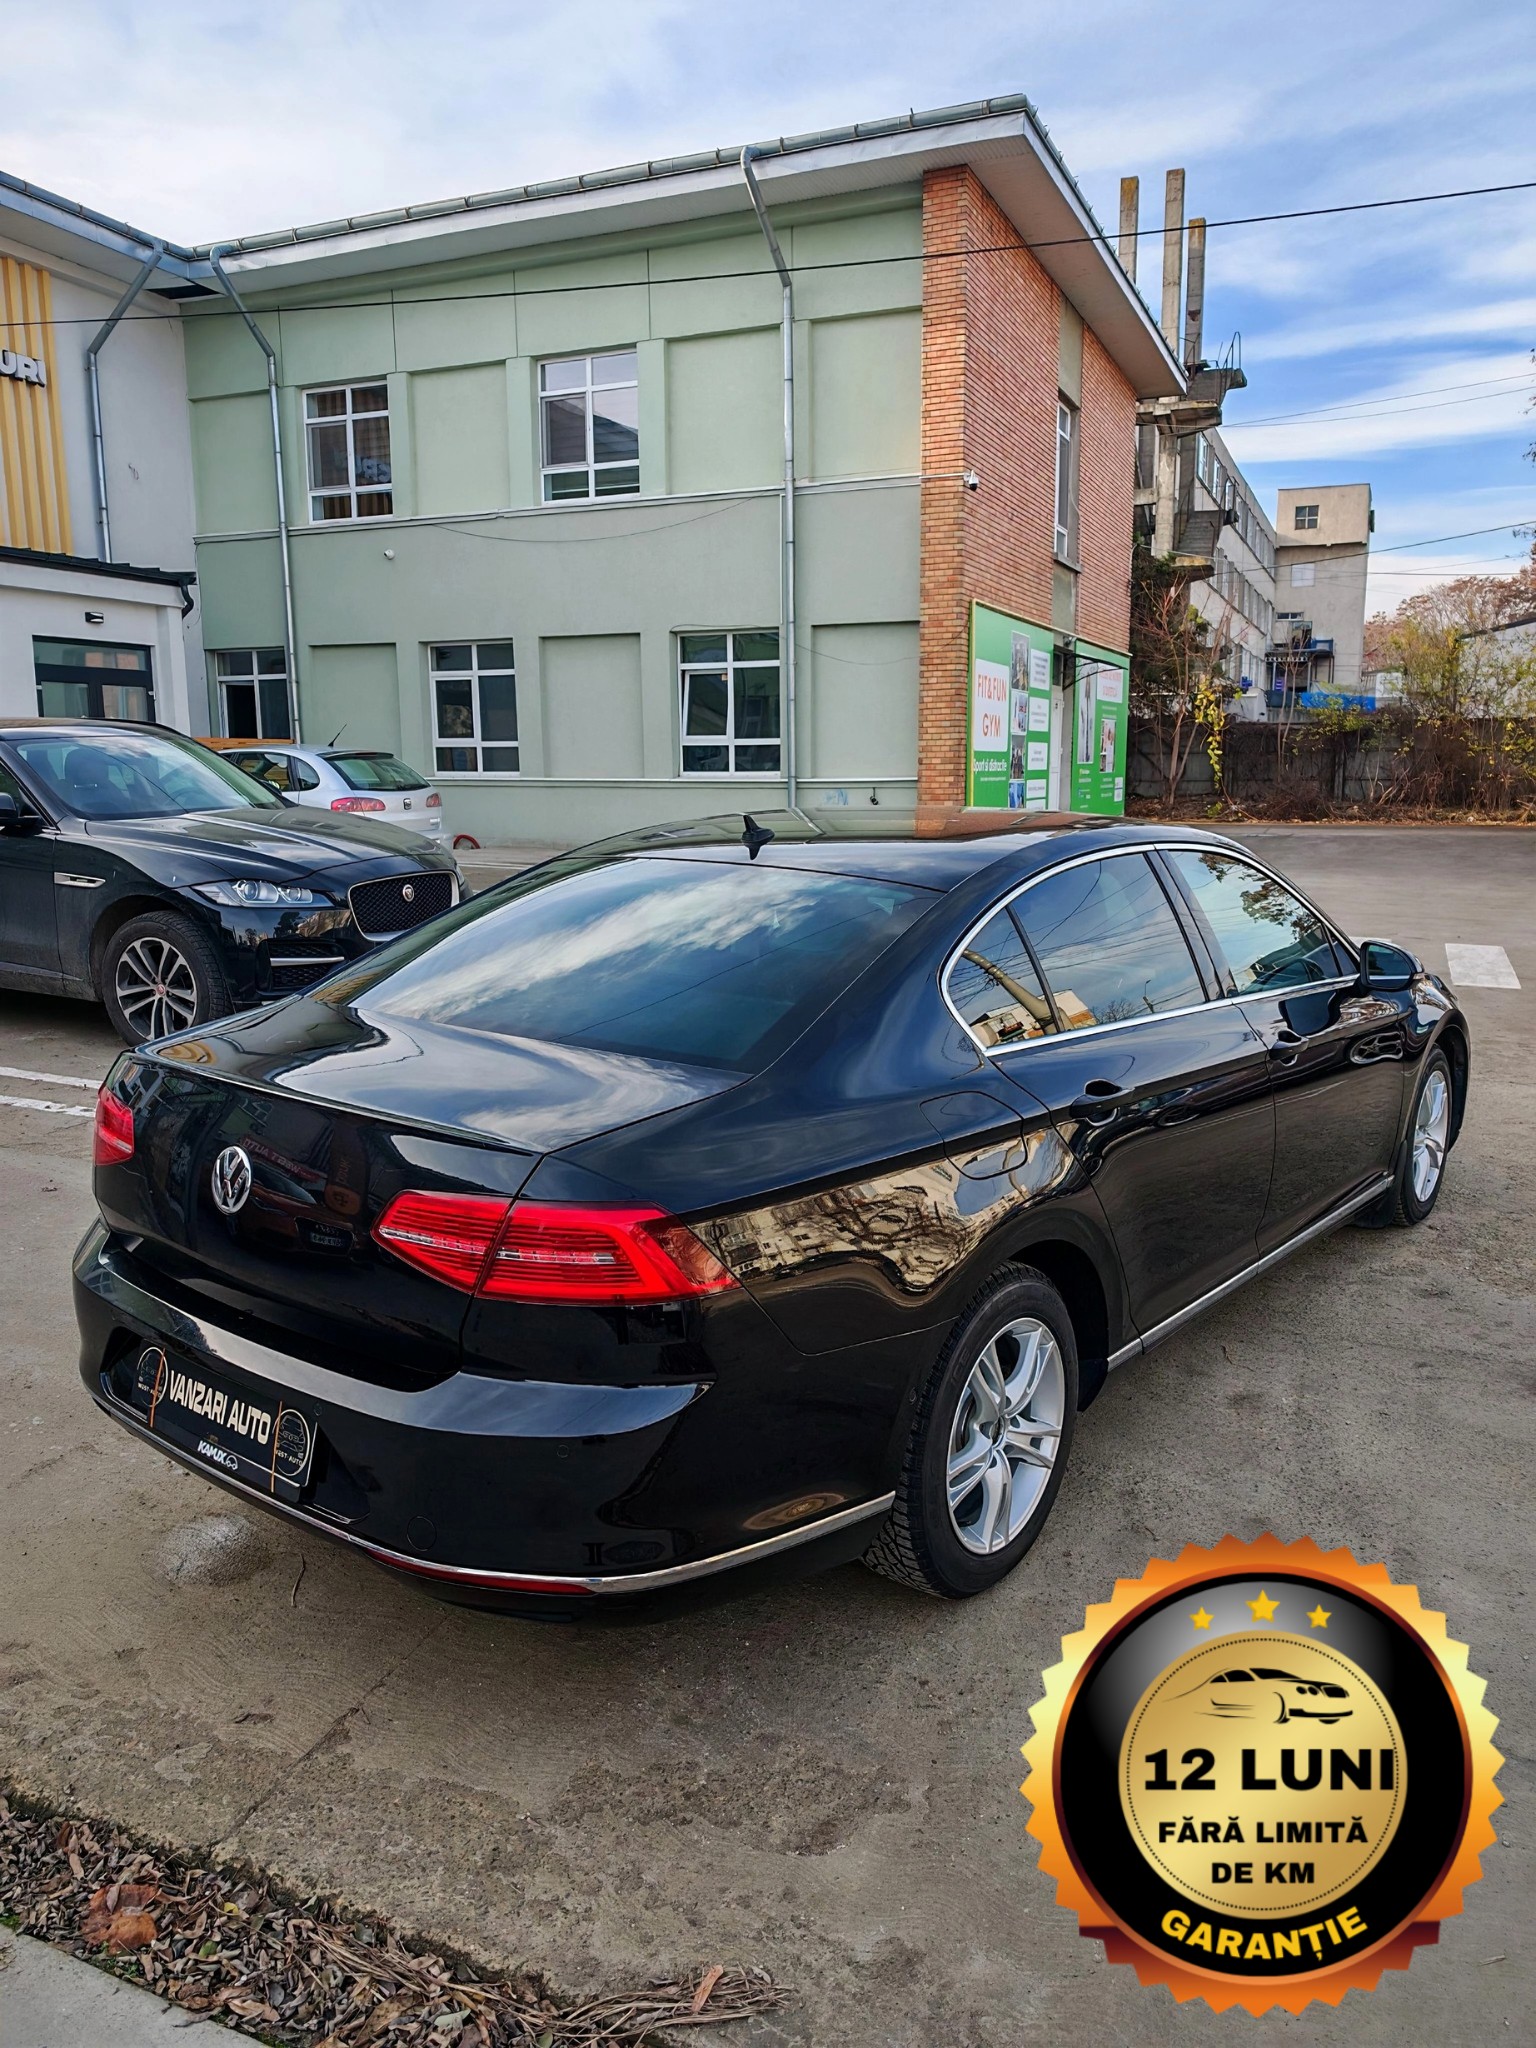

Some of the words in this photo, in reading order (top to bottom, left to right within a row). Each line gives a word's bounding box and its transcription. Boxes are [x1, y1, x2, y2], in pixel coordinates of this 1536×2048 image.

[982, 713, 1001, 738] GYM
[169, 1370, 228, 1425] VANZARI
[226, 1399, 272, 1445] AUTO
